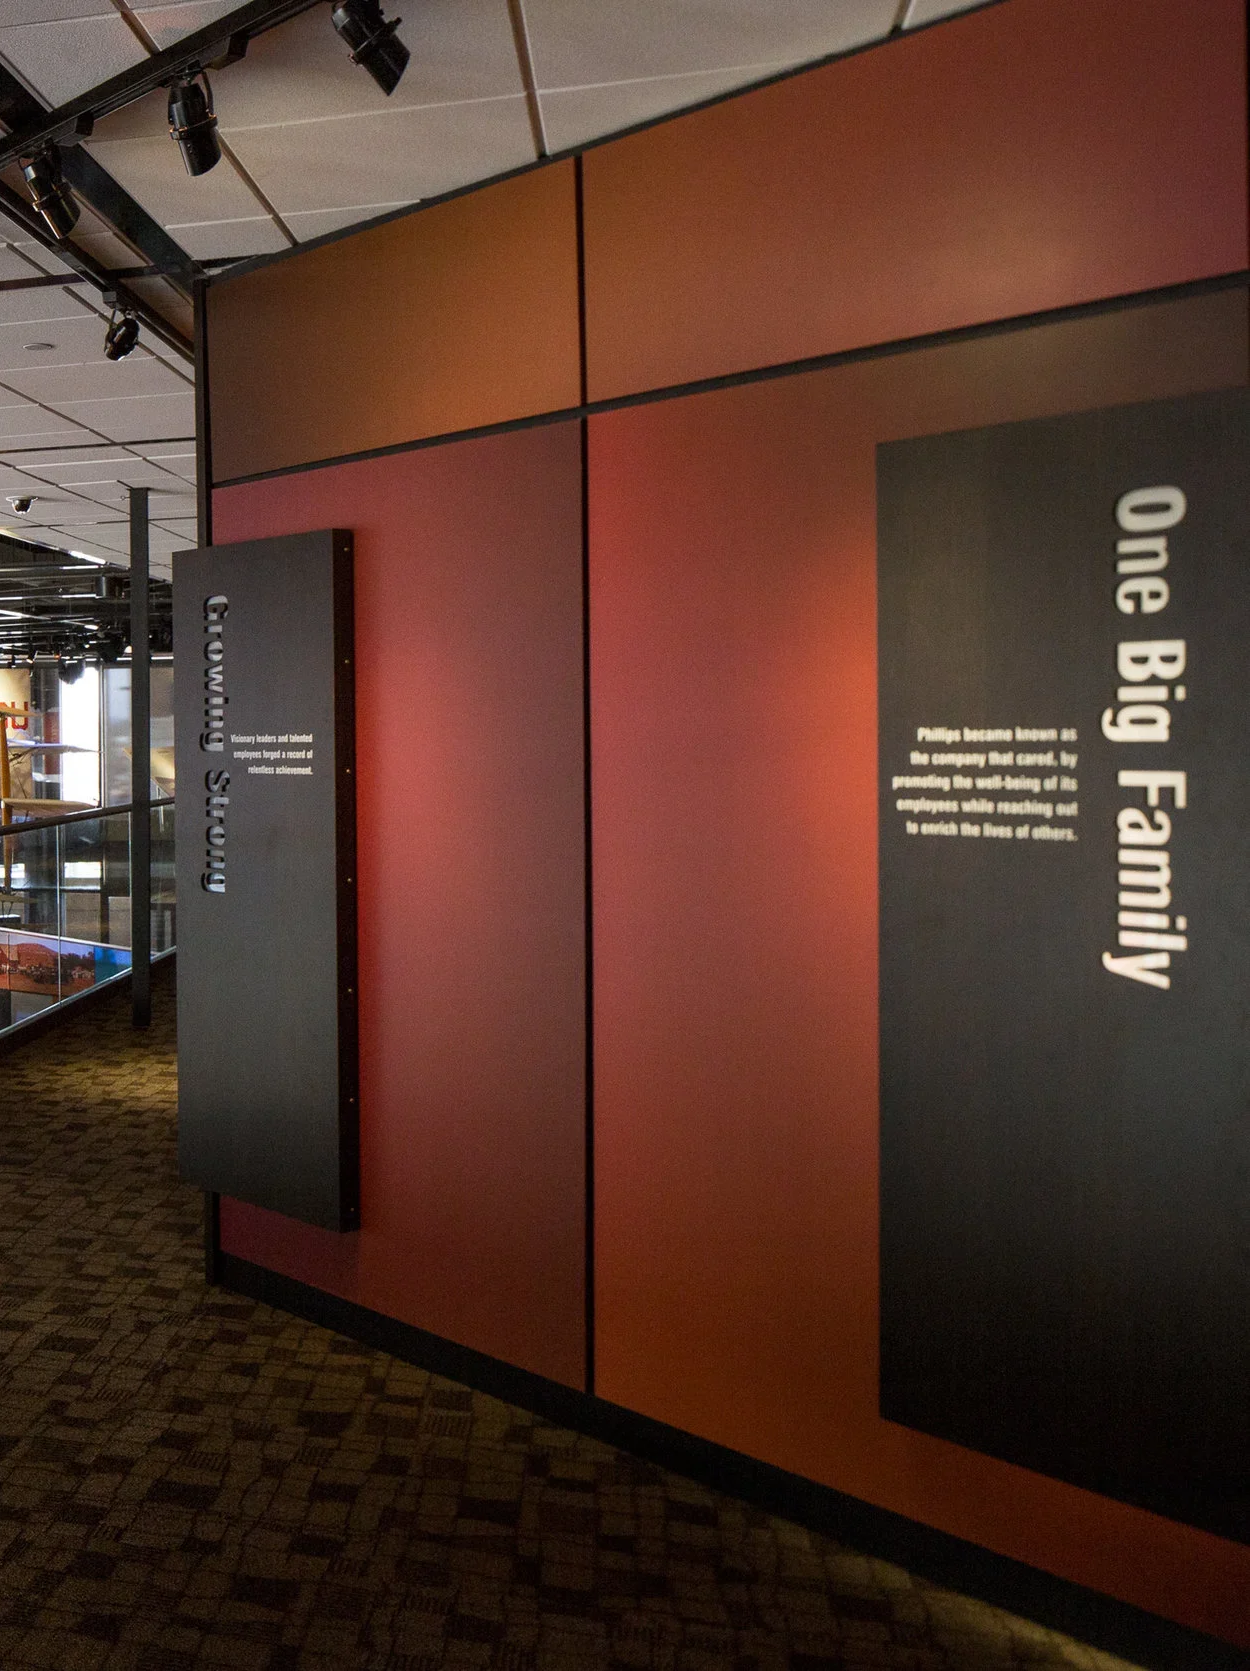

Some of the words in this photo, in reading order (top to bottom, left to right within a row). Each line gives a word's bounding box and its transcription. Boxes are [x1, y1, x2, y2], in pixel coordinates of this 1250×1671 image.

[1116, 485, 1187, 614] One
[201, 595, 229, 751] Growing
[1101, 639, 1187, 743] Big
[230, 734, 255, 745] Visionary
[256, 734, 276, 743] leaders
[277, 734, 288, 743] and
[289, 734, 313, 743] talented
[917, 727, 961, 744] Phillips
[963, 727, 1013, 742] became
[1015, 727, 1057, 742] known
[1060, 728, 1078, 742] as
[233, 749, 262, 760] employees
[263, 749, 280, 760] forged
[281, 751, 286, 759] a
[287, 749, 306, 759] record
[306, 749, 314, 759] of
[910, 751, 930, 765] the
[931, 753, 986, 768] company
[988, 751, 1014, 766] that
[1060, 751, 1078, 769] by
[247, 765, 274, 774] relentless
[275, 765, 314, 775] achievement.
[892, 774, 950, 792] promoting
[952, 774, 973, 789] the
[975, 774, 1041, 793] well-being
[1043, 775, 1058, 791] of
[1060, 775, 1078, 791] its
[896, 797, 959, 814] employees
[961, 797, 995, 814] while
[997, 799, 1053, 818] reaching
[1055, 801, 1078, 817] out
[201, 770, 230, 893] Strong
[906, 820, 918, 835] to
[920, 820, 958, 836] enrich
[960, 821, 981, 837] the
[982, 822, 1013, 839] lives
[1015, 823, 1030, 839] of
[1031, 824, 1078, 841] others.
[1102, 770, 1187, 990] Family
